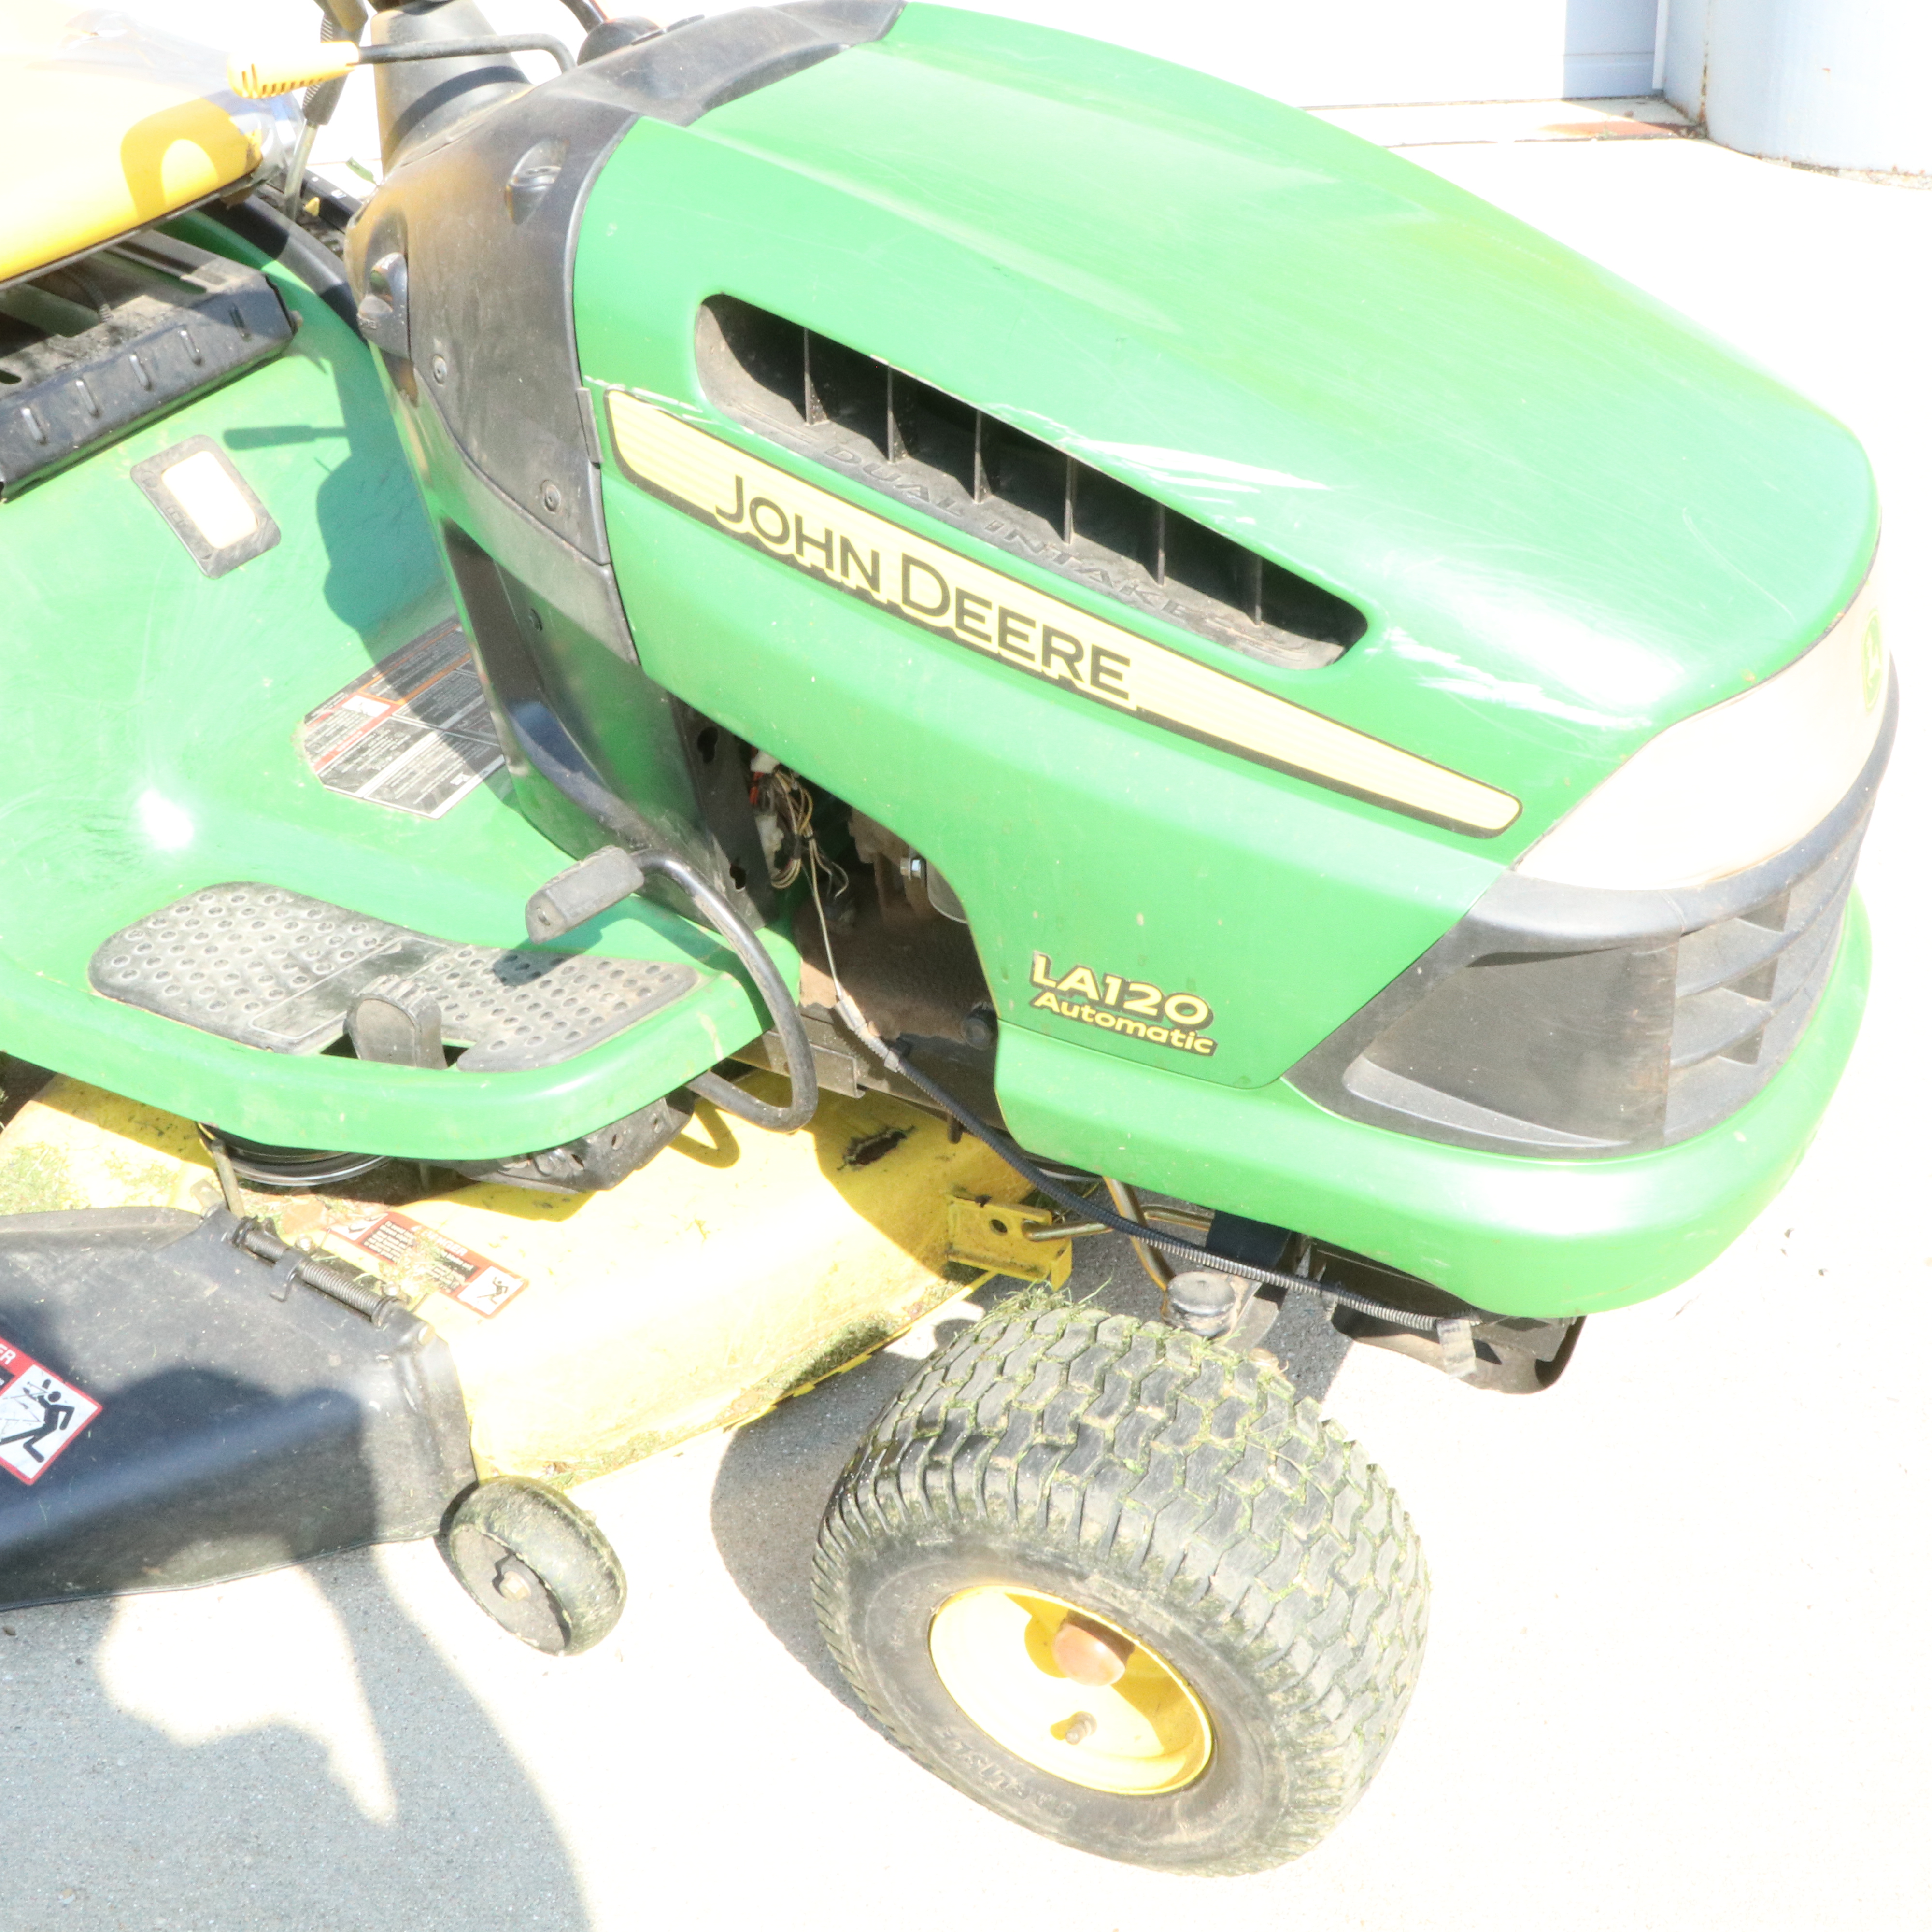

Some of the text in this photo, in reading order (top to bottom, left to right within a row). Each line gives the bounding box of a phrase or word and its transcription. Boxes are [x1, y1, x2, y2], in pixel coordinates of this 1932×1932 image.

[715, 475, 1131, 700] JOHN DEERE
[825, 447, 1193, 615] DUAL INTAKE
[1031, 953, 1211, 1027] LA120
[1032, 991, 1215, 1054] Automatic
